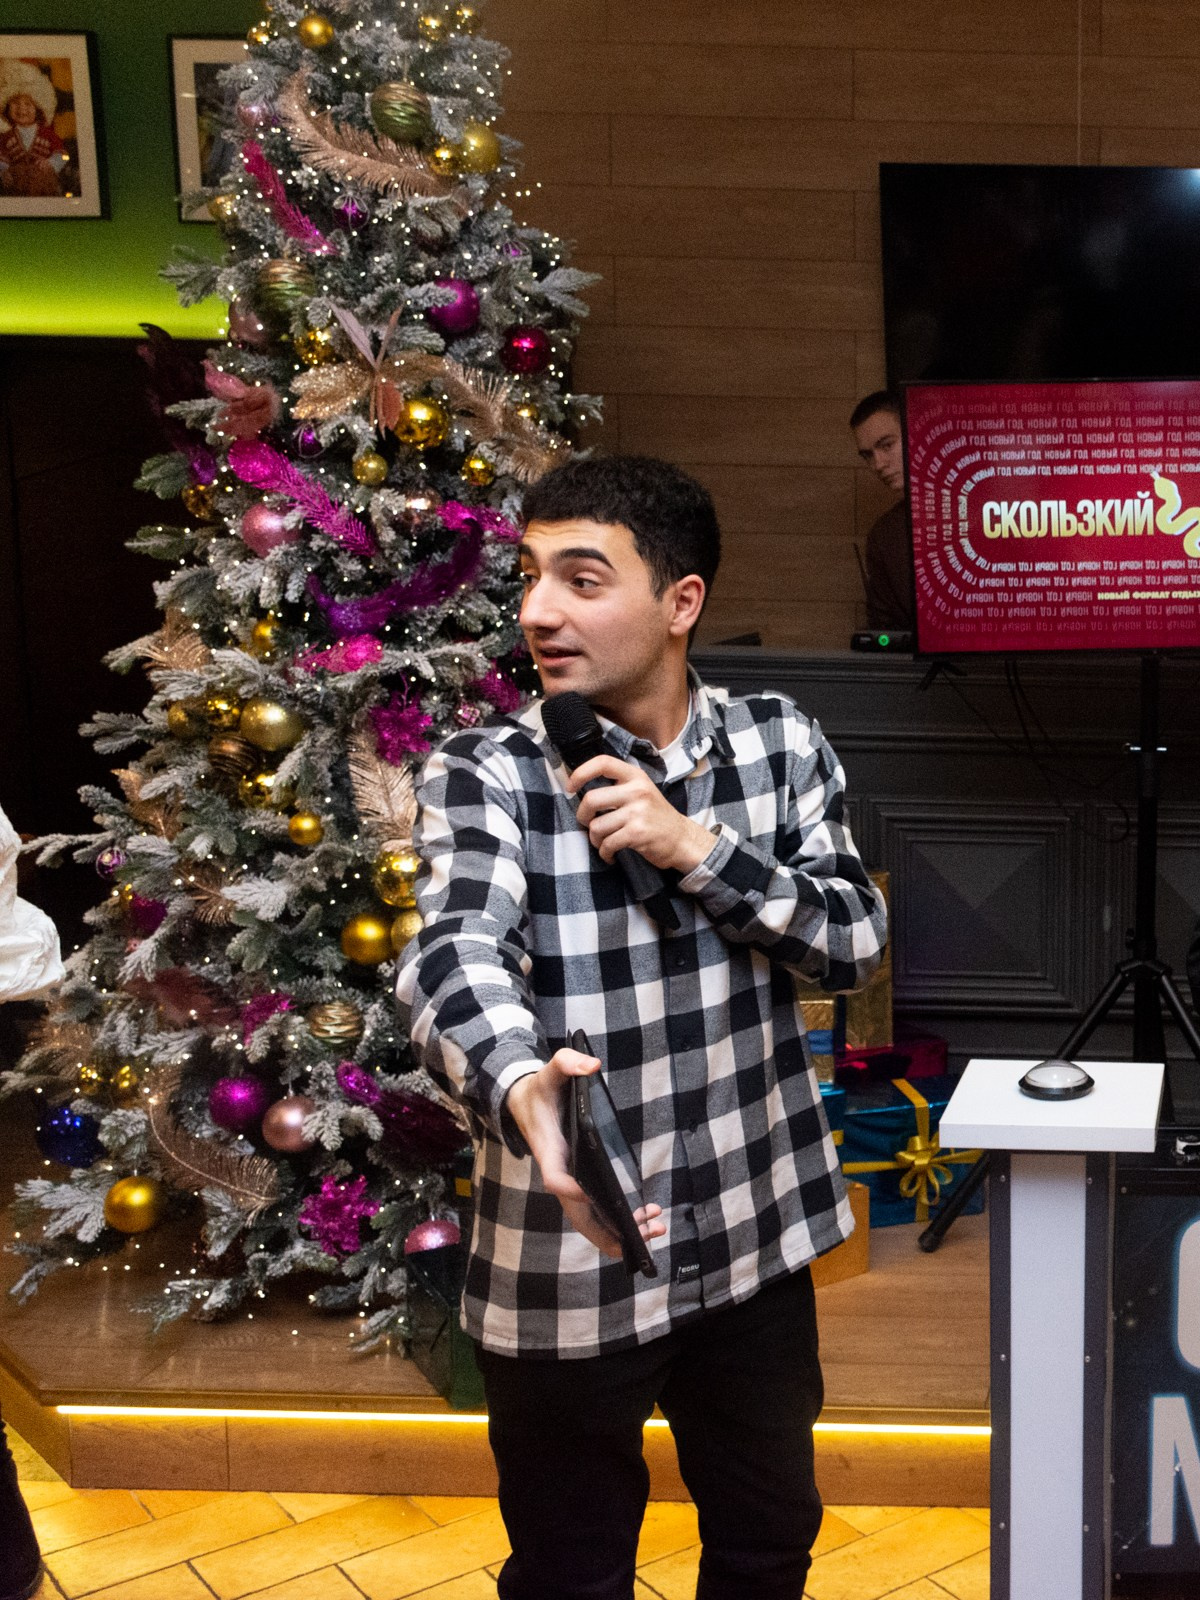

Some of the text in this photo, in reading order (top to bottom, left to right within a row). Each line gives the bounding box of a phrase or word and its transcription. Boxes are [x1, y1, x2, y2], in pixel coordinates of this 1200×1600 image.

[982, 490, 1155, 539] СКОЛЬЗКИЙ
[1098, 590, 1130, 600] НОВЫЙ
[1132, 591, 1170, 600] ФОРМАТ
